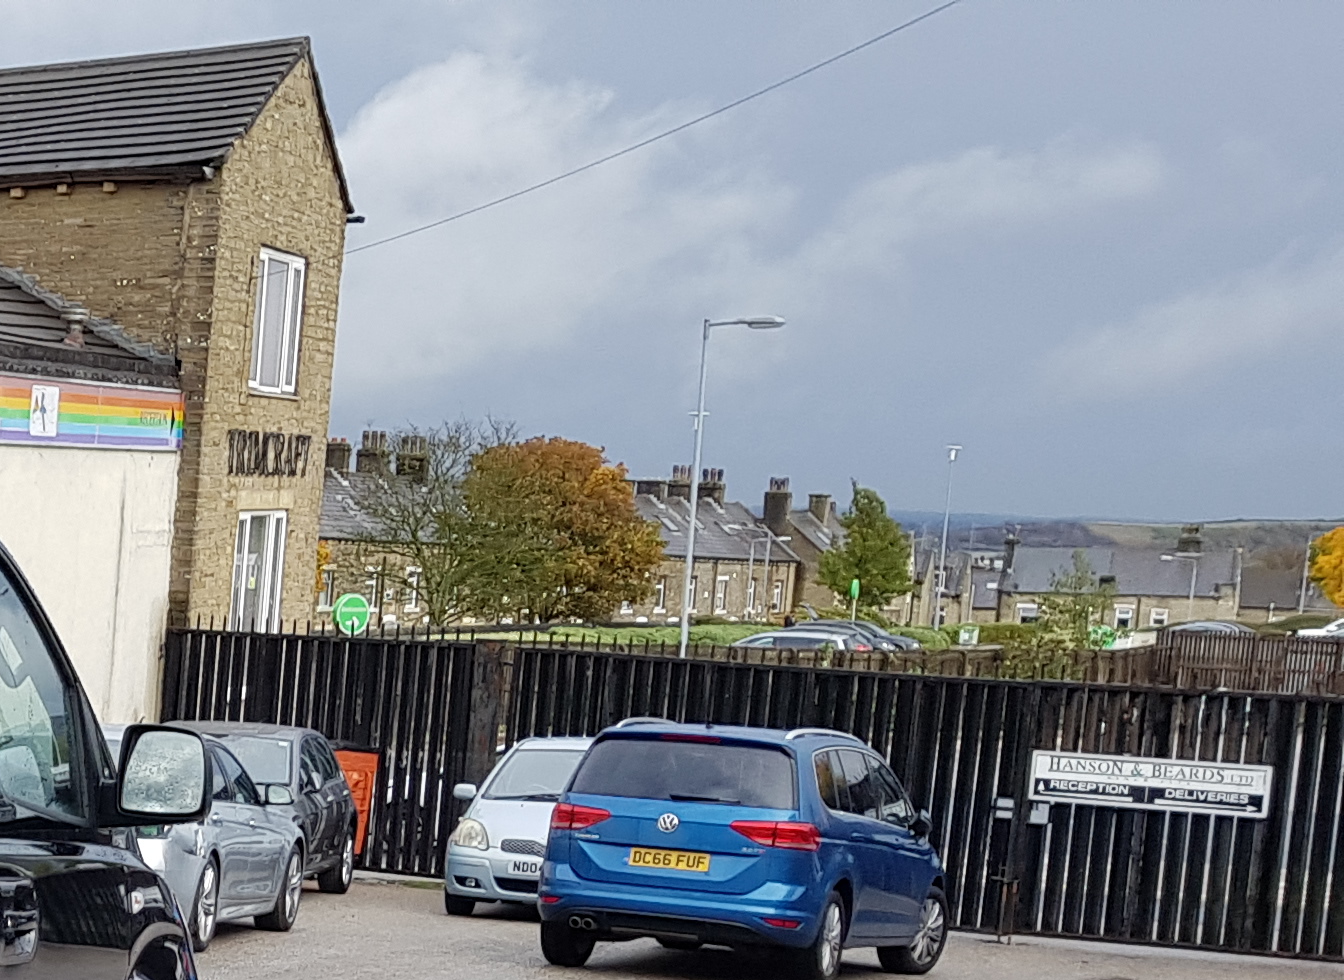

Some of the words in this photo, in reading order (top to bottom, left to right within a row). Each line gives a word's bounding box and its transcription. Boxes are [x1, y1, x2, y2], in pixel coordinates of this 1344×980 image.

[226, 429, 312, 478] TRIMCRAFT
[1048, 755, 1123, 776] HANSON
[1131, 762, 1144, 777] &
[1152, 764, 1224, 783] BEARDS
[1049, 779, 1130, 795] RECEPTION
[1164, 788, 1250, 804] DELIVERIES
[632, 851, 672, 867] DC66
[675, 854, 707, 869] FUF
